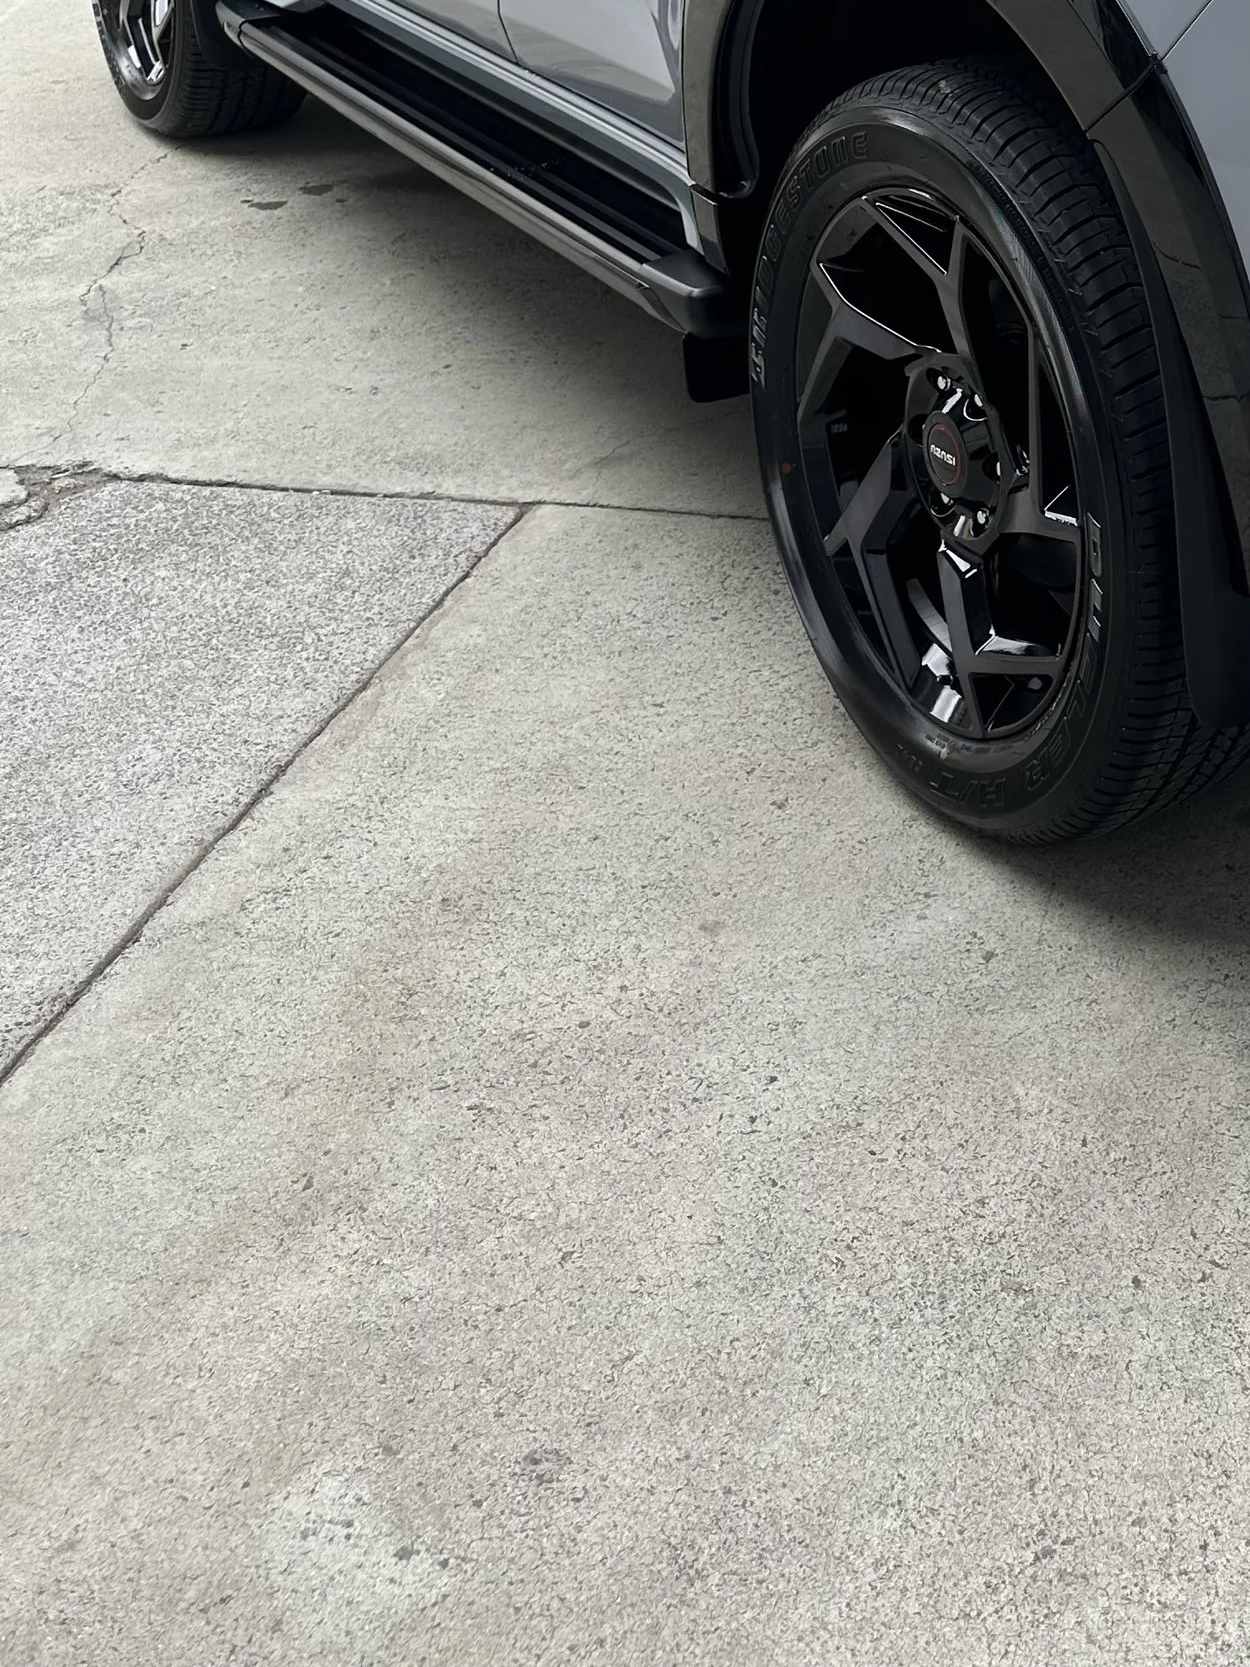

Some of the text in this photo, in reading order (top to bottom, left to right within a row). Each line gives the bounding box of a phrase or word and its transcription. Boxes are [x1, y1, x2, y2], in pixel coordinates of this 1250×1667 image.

[749, 130, 870, 391] BRIDGESTONE
[930, 444, 956, 466] ISUZU
[1024, 510, 1104, 791] DUELER
